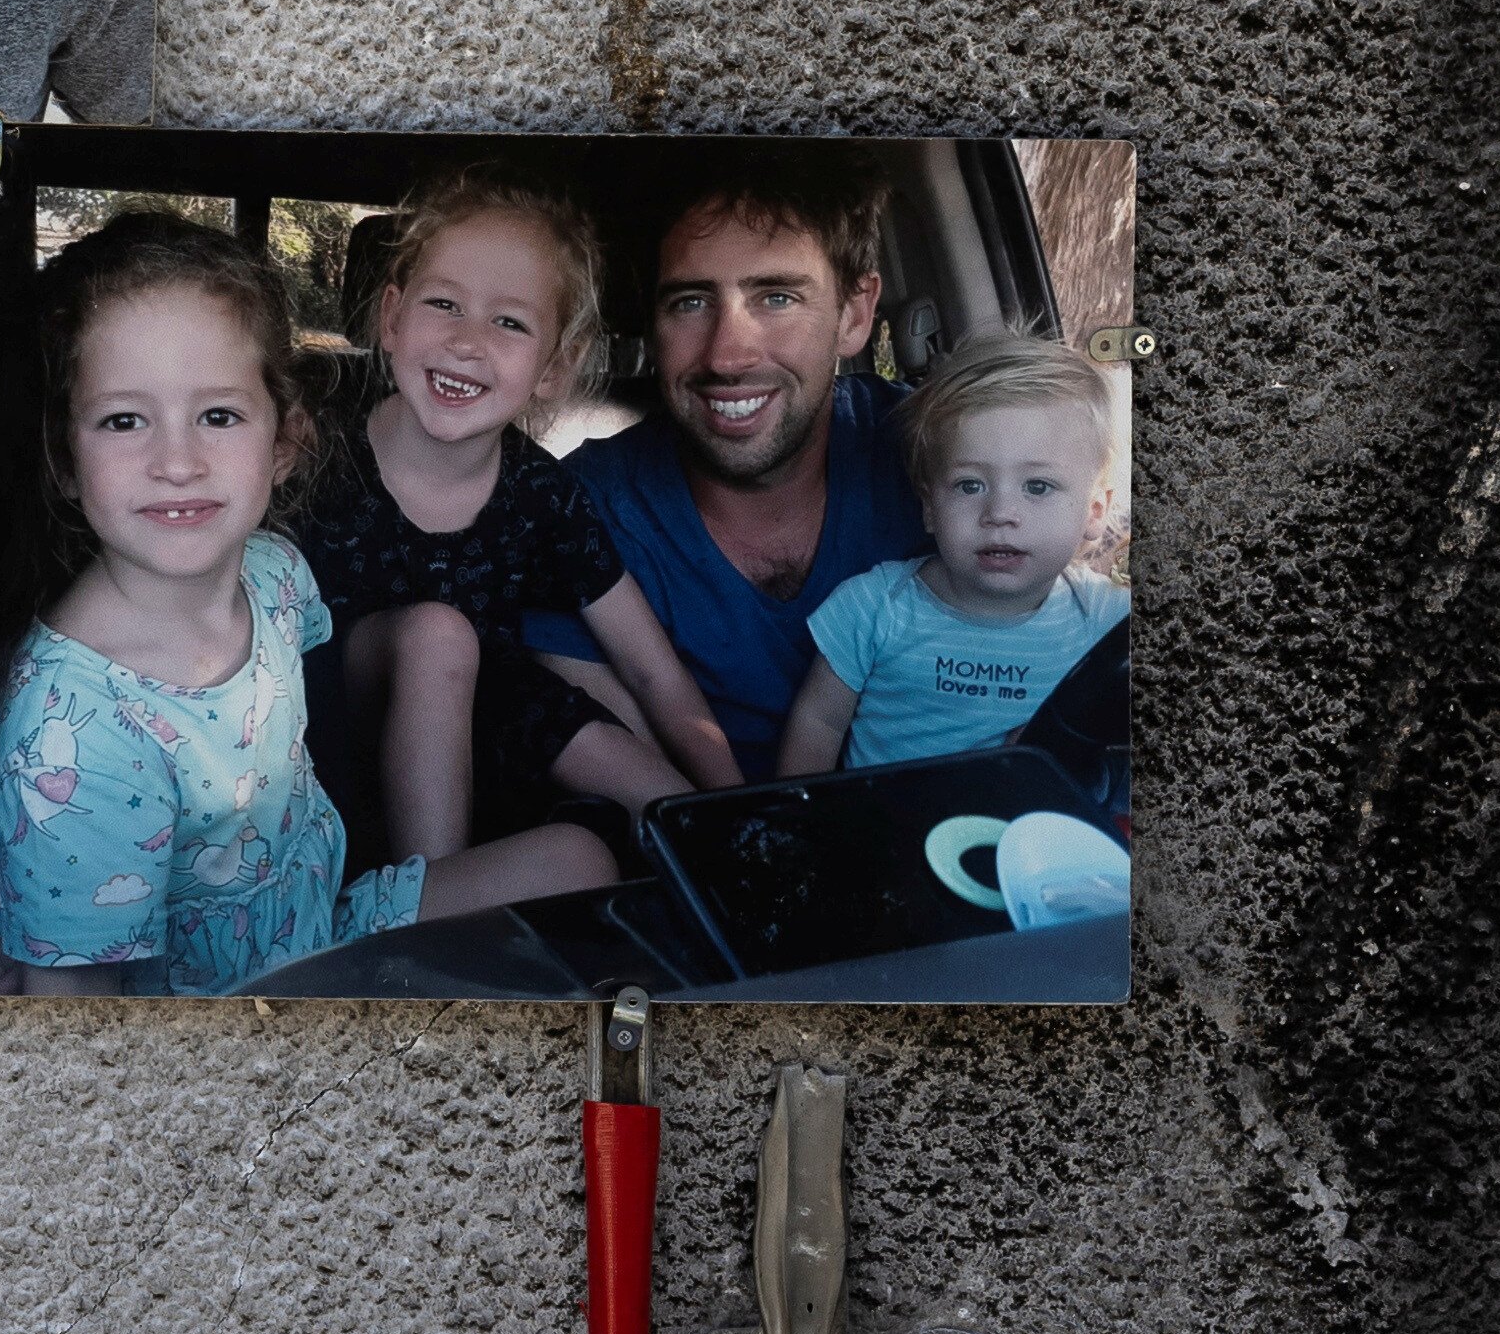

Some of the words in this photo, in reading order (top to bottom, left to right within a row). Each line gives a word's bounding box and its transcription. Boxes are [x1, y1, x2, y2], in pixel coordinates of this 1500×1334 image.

[935, 656, 1030, 683] MOMMY
[936, 674, 989, 697] loves
[998, 686, 1028, 701] me
